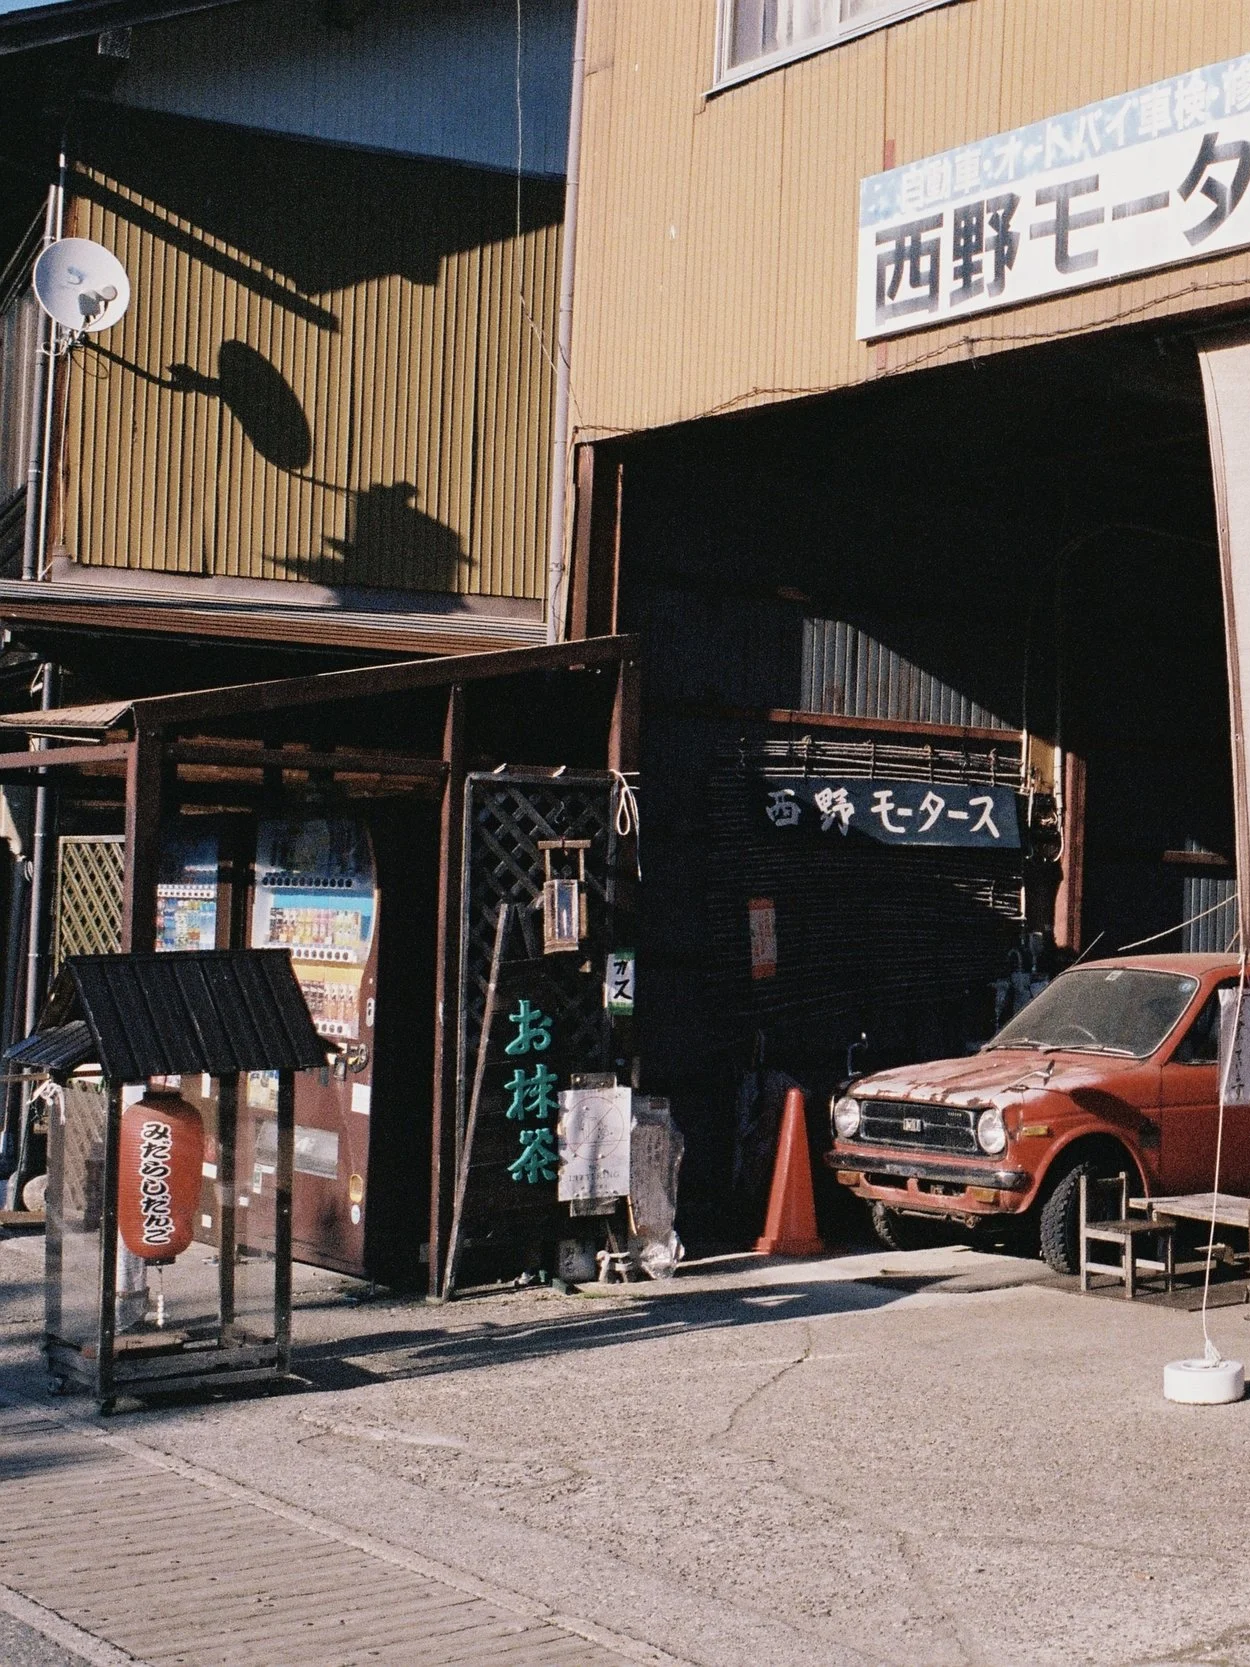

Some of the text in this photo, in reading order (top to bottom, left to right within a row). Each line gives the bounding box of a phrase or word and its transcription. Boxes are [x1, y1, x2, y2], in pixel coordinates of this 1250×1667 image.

[766, 787, 1000, 838] 西野モータース
[504, 999, 561, 1184] お抹茶
[139, 1121, 175, 1245] みだらしだんご
